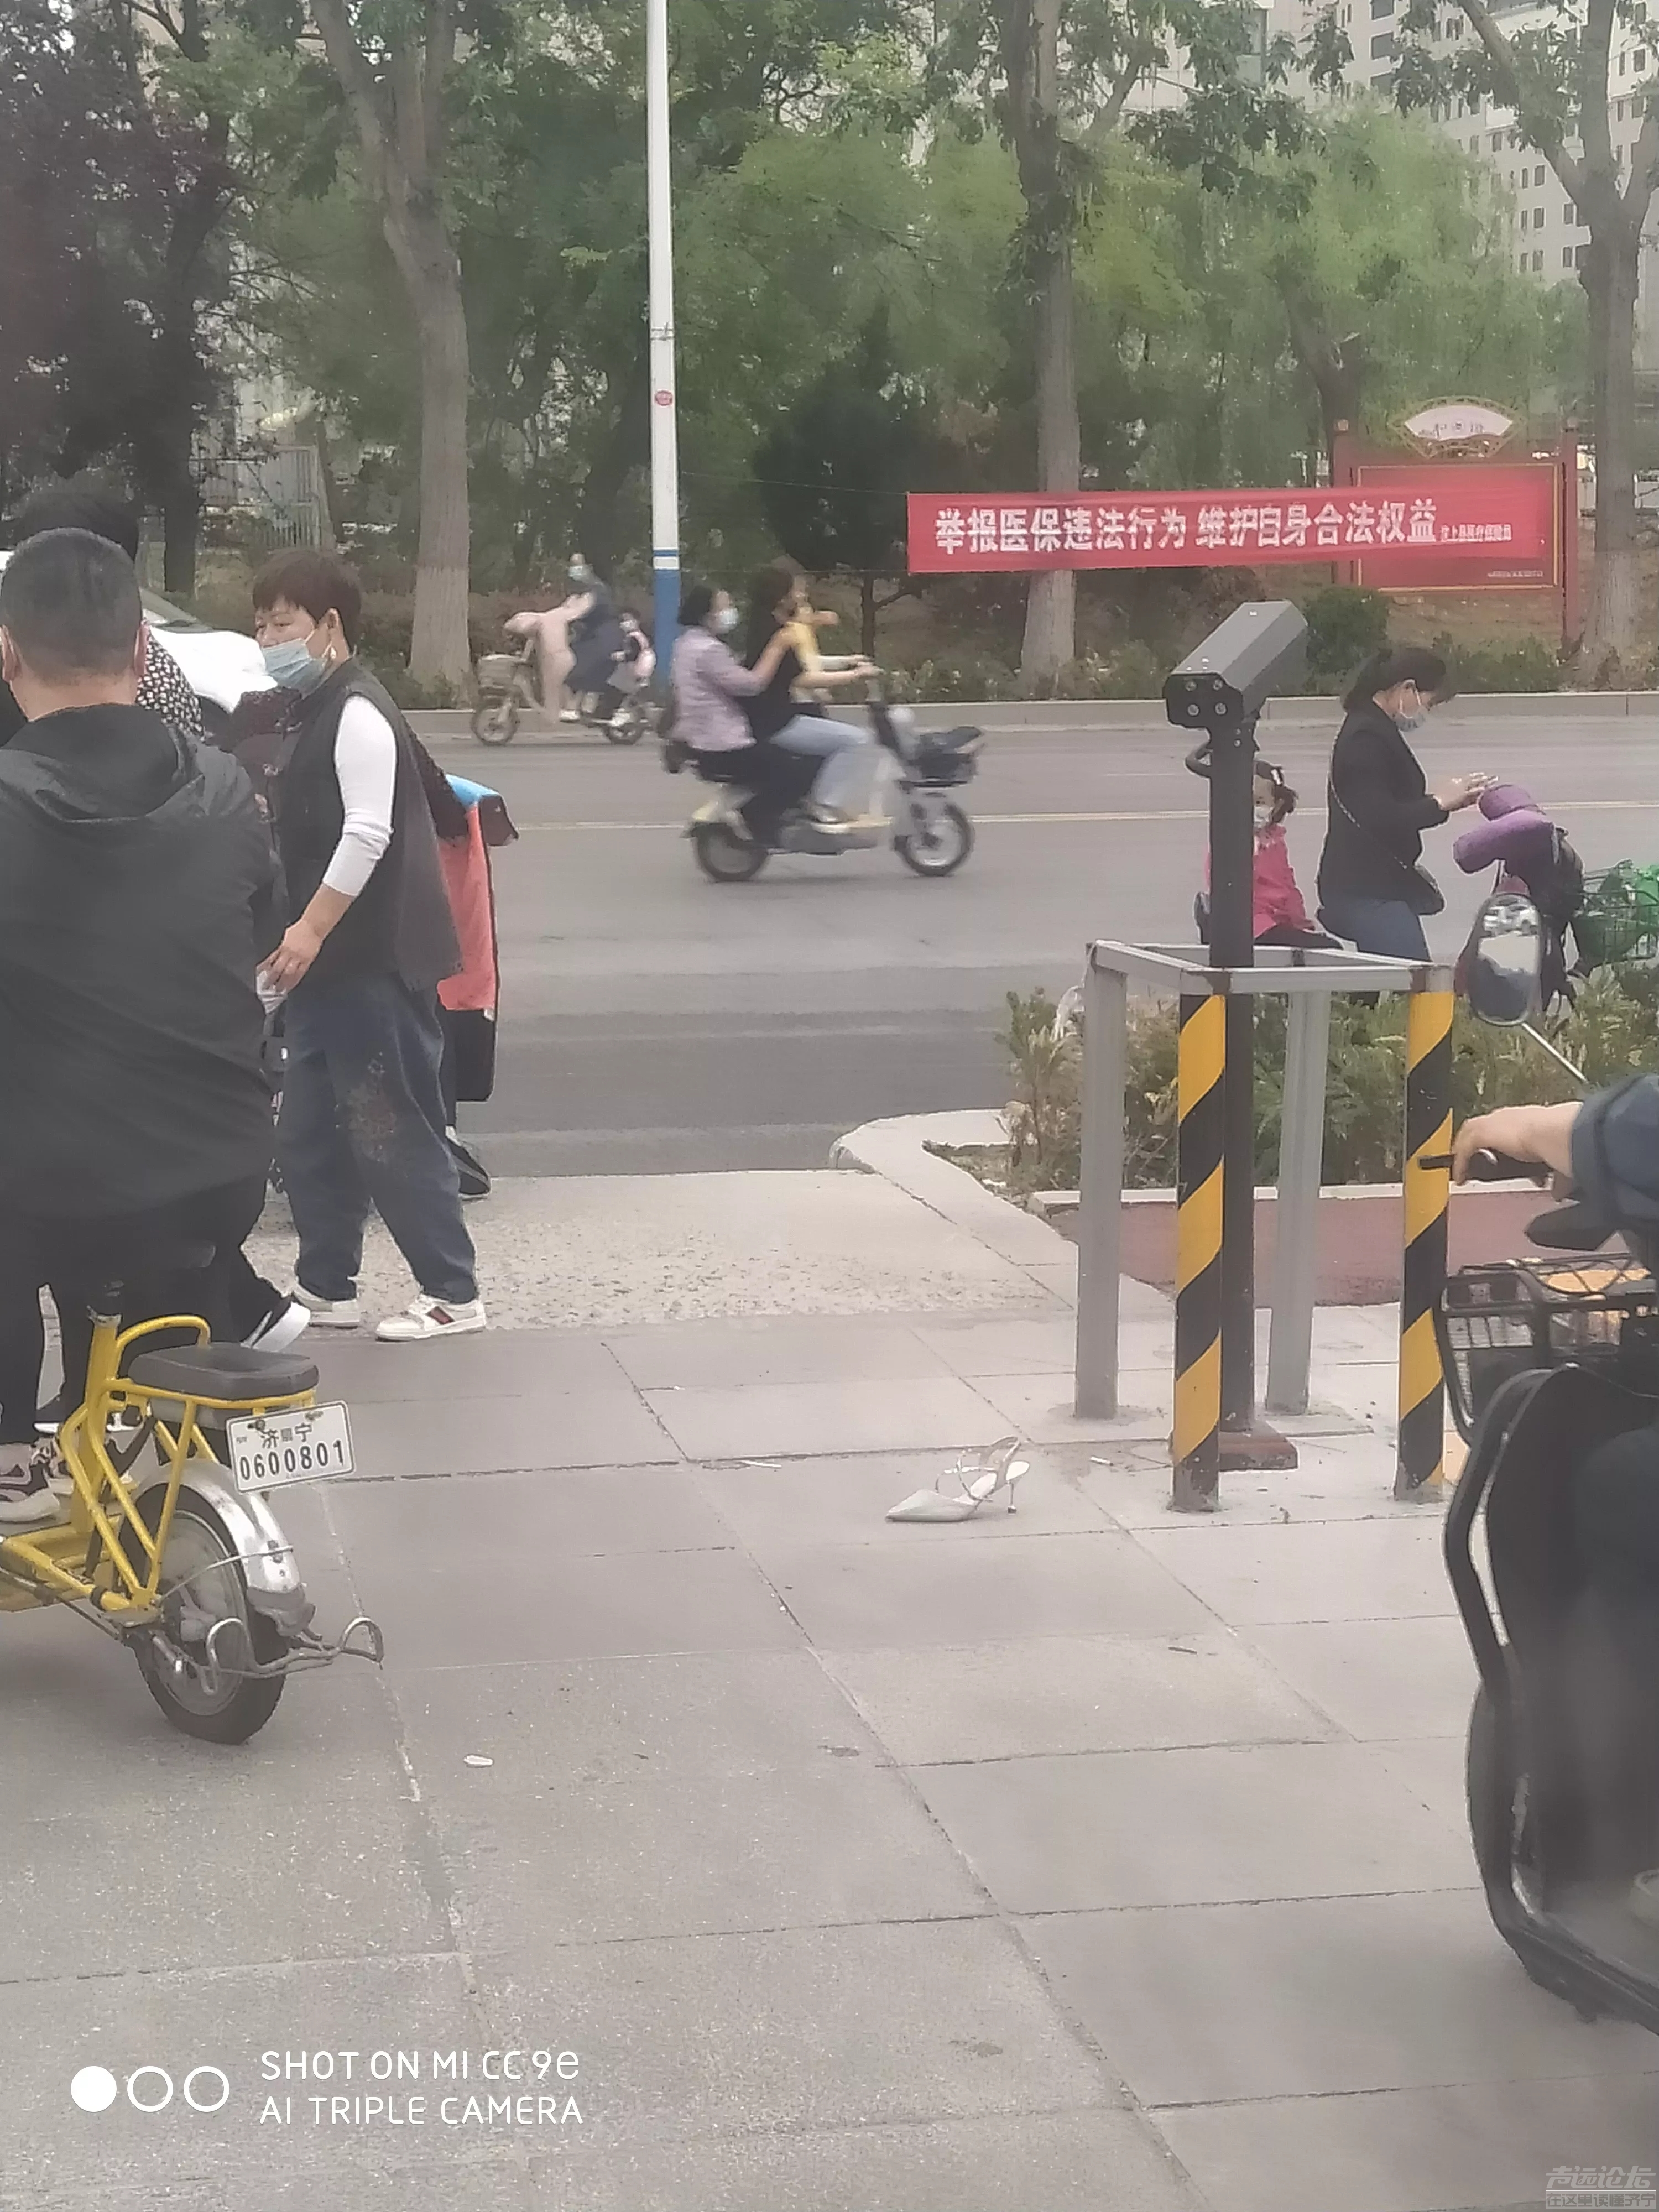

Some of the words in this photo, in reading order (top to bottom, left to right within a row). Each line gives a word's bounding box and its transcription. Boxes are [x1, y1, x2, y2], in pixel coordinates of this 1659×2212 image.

[935, 507, 1187, 555] 举报医保违法行为
[1196, 498, 1437, 549] 维护自身合法权益
[239, 1439, 343, 1481] 0600801
